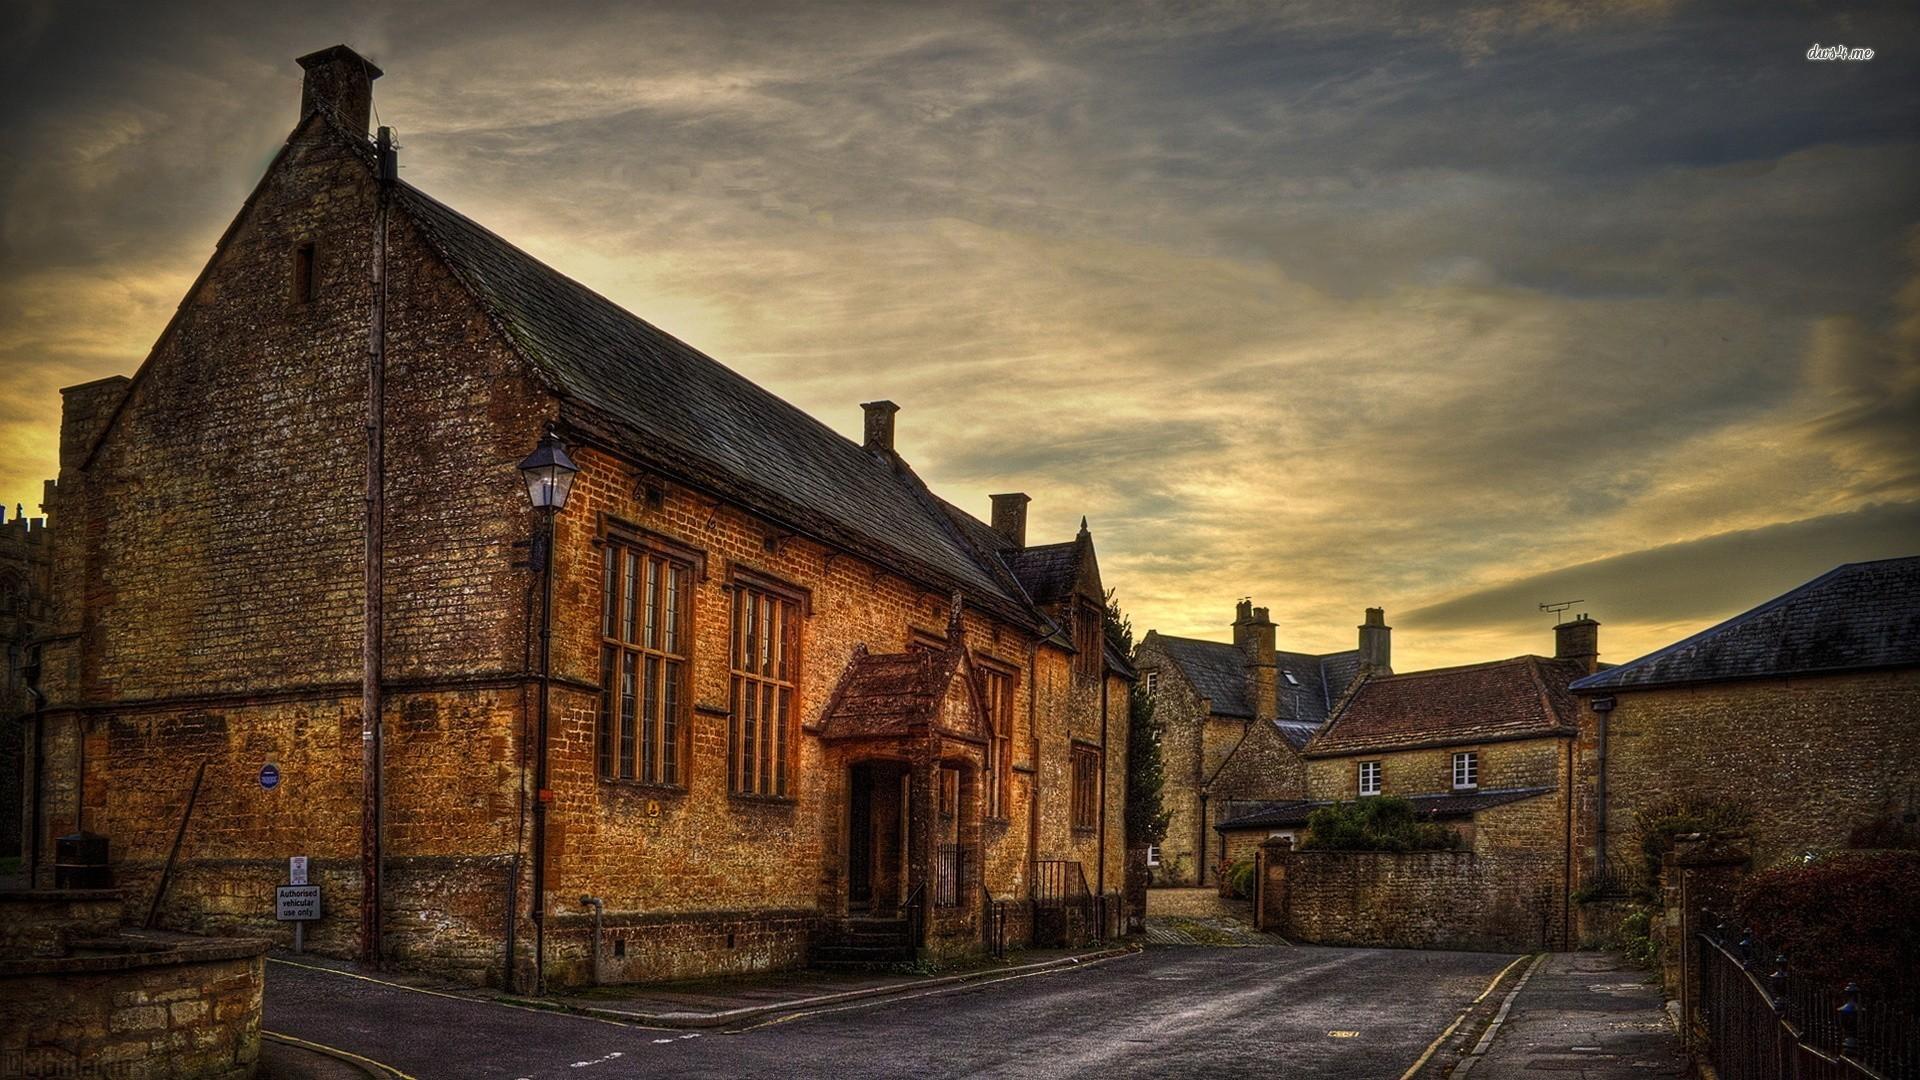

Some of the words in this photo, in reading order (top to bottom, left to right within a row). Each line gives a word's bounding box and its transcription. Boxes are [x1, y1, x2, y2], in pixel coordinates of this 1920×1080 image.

[280, 889, 318, 898] Authorised
[282, 899, 314, 907] vehicular
[297, 908, 313, 917] only
